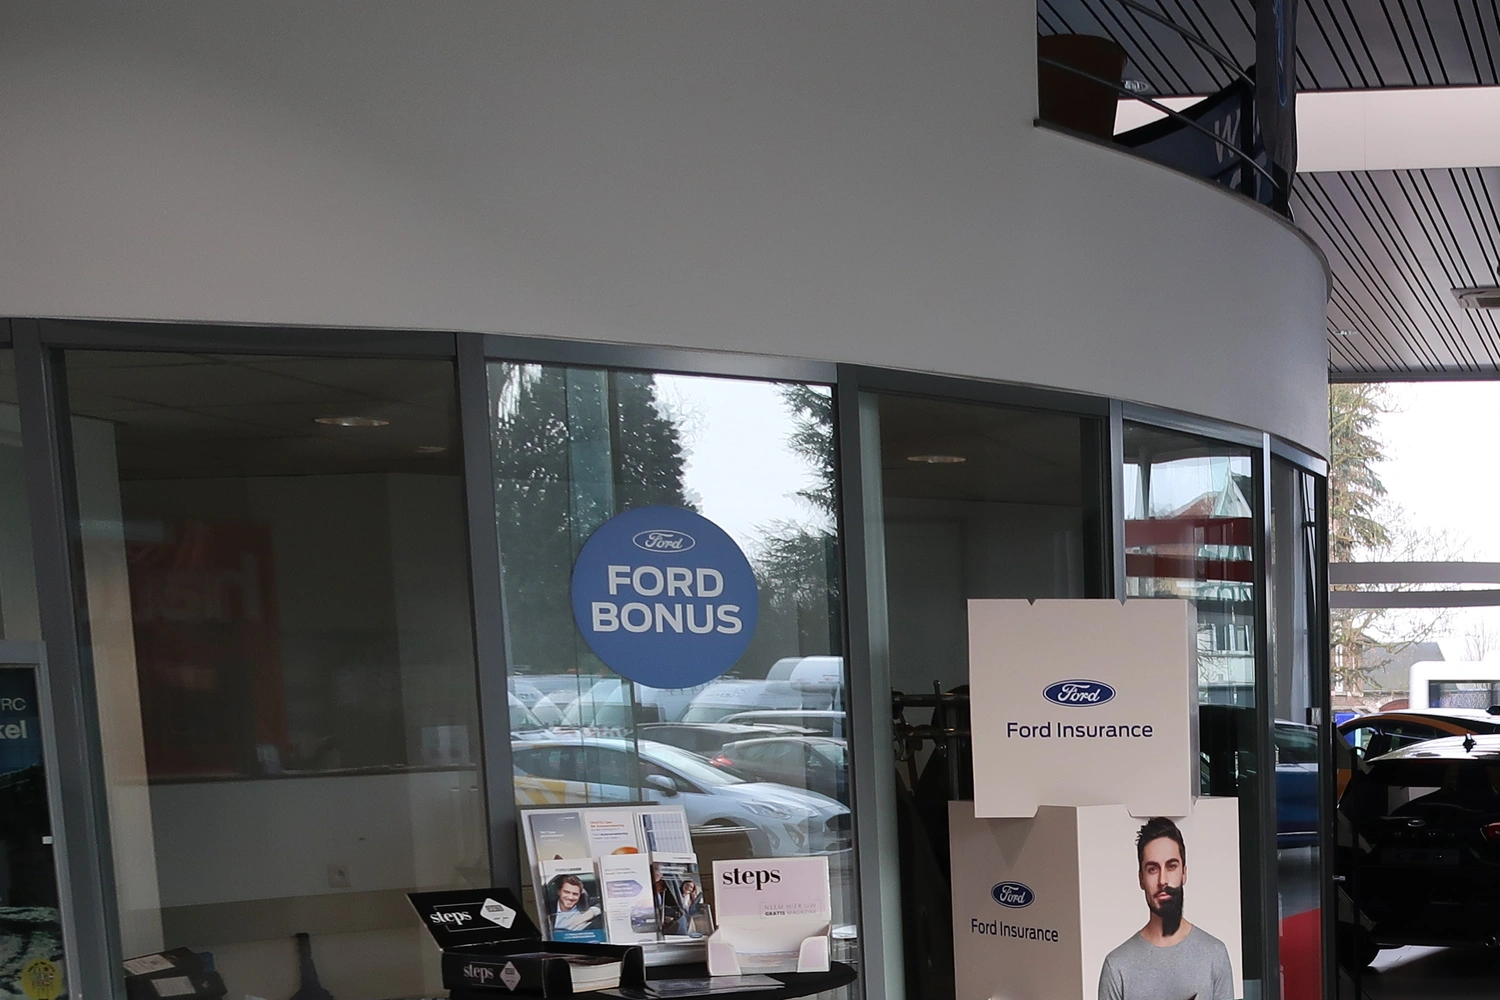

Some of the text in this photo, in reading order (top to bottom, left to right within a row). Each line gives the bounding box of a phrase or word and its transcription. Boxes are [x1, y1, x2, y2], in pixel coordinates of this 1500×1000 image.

[645, 532, 684, 549] Ford
[608, 565, 724, 598] FORD
[591, 601, 743, 634] BONUS
[1057, 683, 1101, 703] Ford
[0, 697, 27, 711] RC
[1007, 722, 1153, 738] Ford Insurance
[722, 867, 781, 891] steps
[999, 886, 1026, 905] Ford
[429, 910, 473, 926] steps
[971, 918, 1059, 943] Ford Insurance
[463, 964, 495, 984] steps
